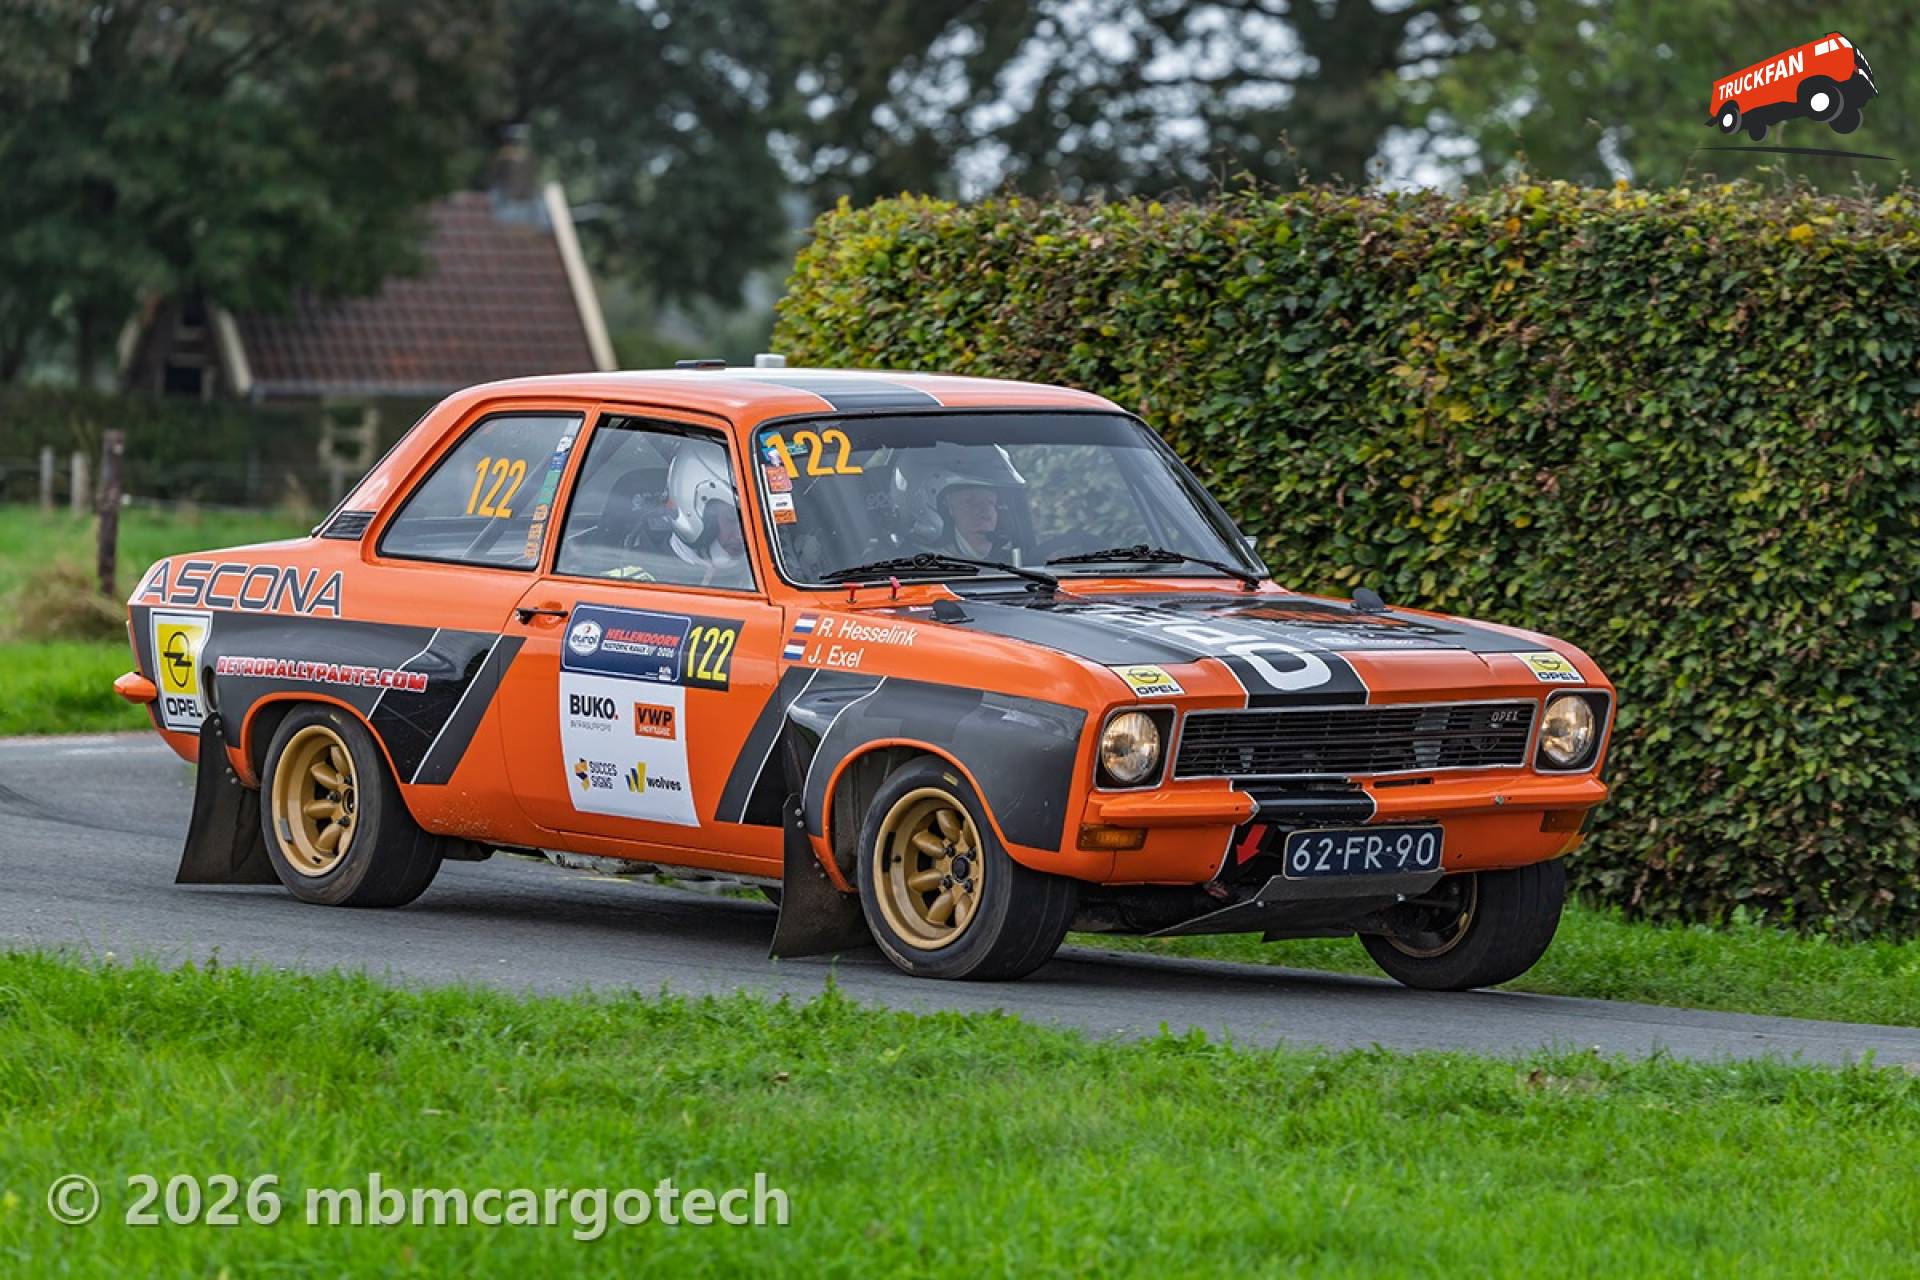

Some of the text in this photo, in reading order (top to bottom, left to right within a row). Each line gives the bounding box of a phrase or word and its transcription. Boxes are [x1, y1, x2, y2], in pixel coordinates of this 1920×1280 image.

[765, 428, 864, 478] 122
[466, 456, 528, 518] 122
[136, 560, 343, 617] ASCONA
[817, 617, 919, 647] R. Hesselink
[687, 627, 737, 682] 122
[807, 643, 865, 668] J. Exel
[216, 655, 430, 692] RETRORALLYPARTS.COM
[1538, 672, 1581, 681] OPEL
[1136, 685, 1180, 695] OPEL
[166, 698, 203, 718] OPEL
[638, 707, 673, 727] VWP
[1490, 711, 1519, 722] OPEL
[646, 776, 682, 791] wolves
